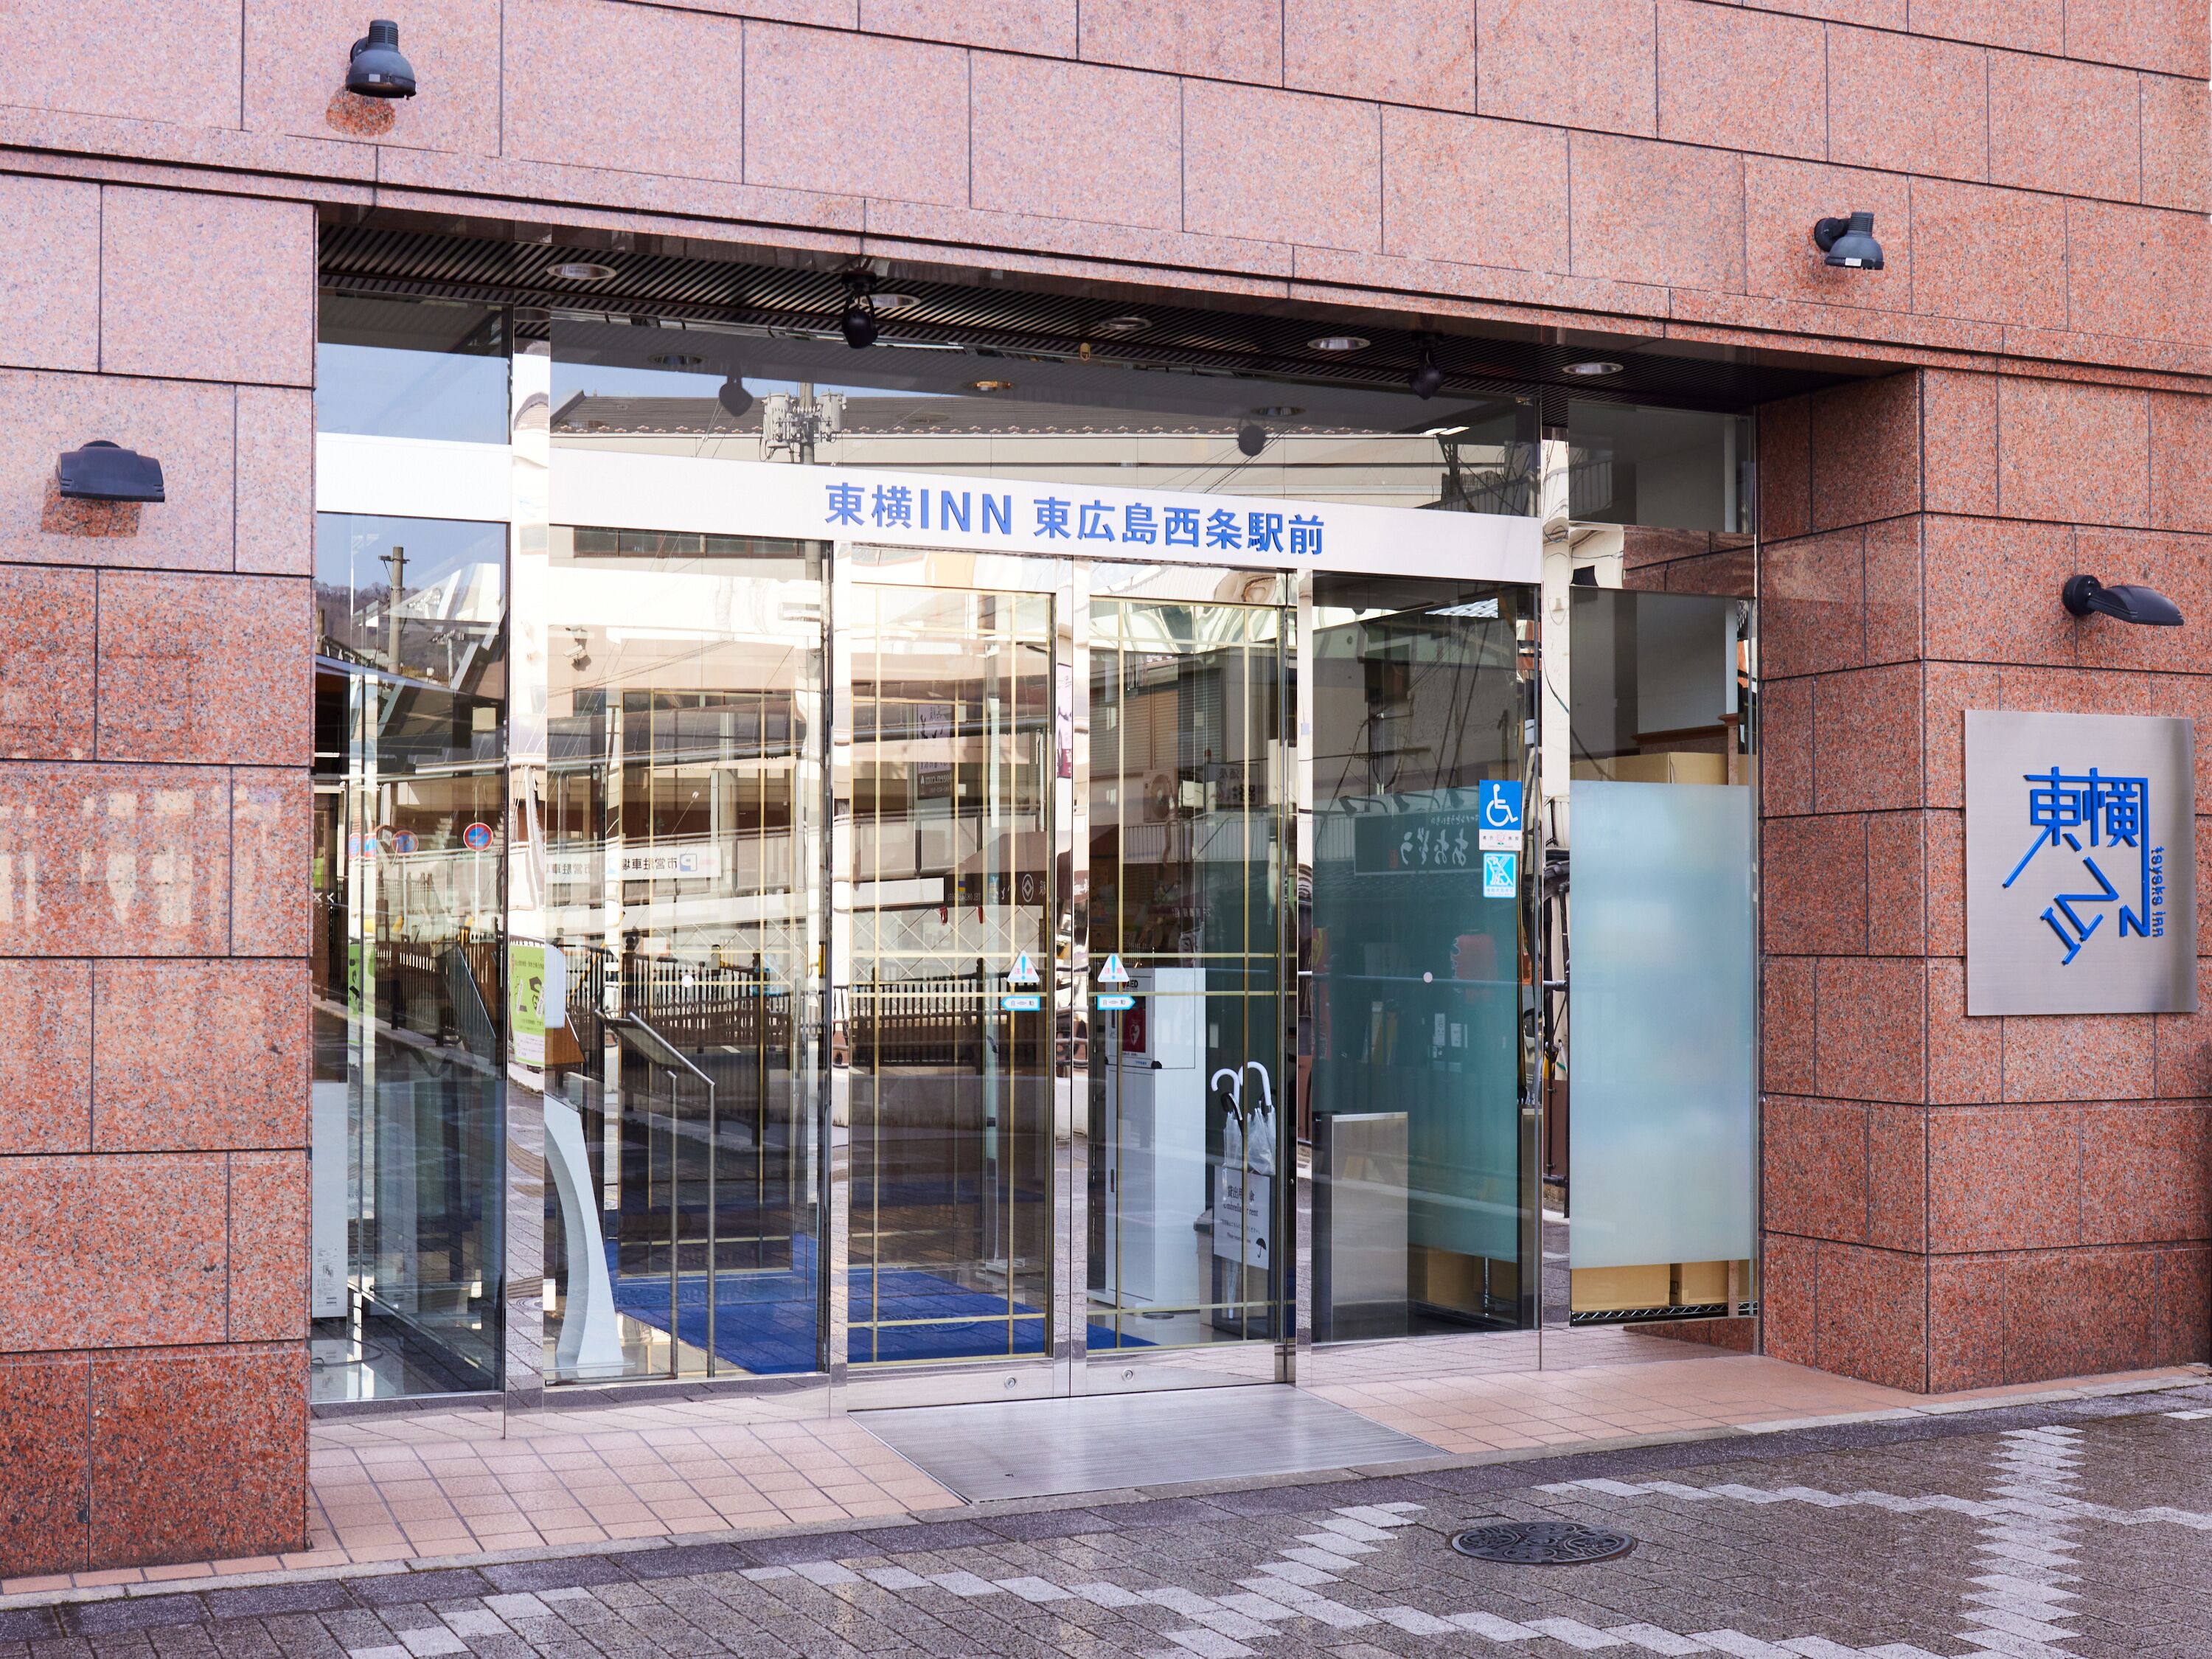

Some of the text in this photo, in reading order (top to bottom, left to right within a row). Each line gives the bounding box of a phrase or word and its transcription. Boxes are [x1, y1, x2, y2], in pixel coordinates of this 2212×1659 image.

[825, 483, 1324, 554] 東横INN 東広島西条駅前
[2150, 846, 2166, 938] toyoko inn
[1126, 979, 1138, 988] AED
[1249, 1208, 1259, 1217] rent
